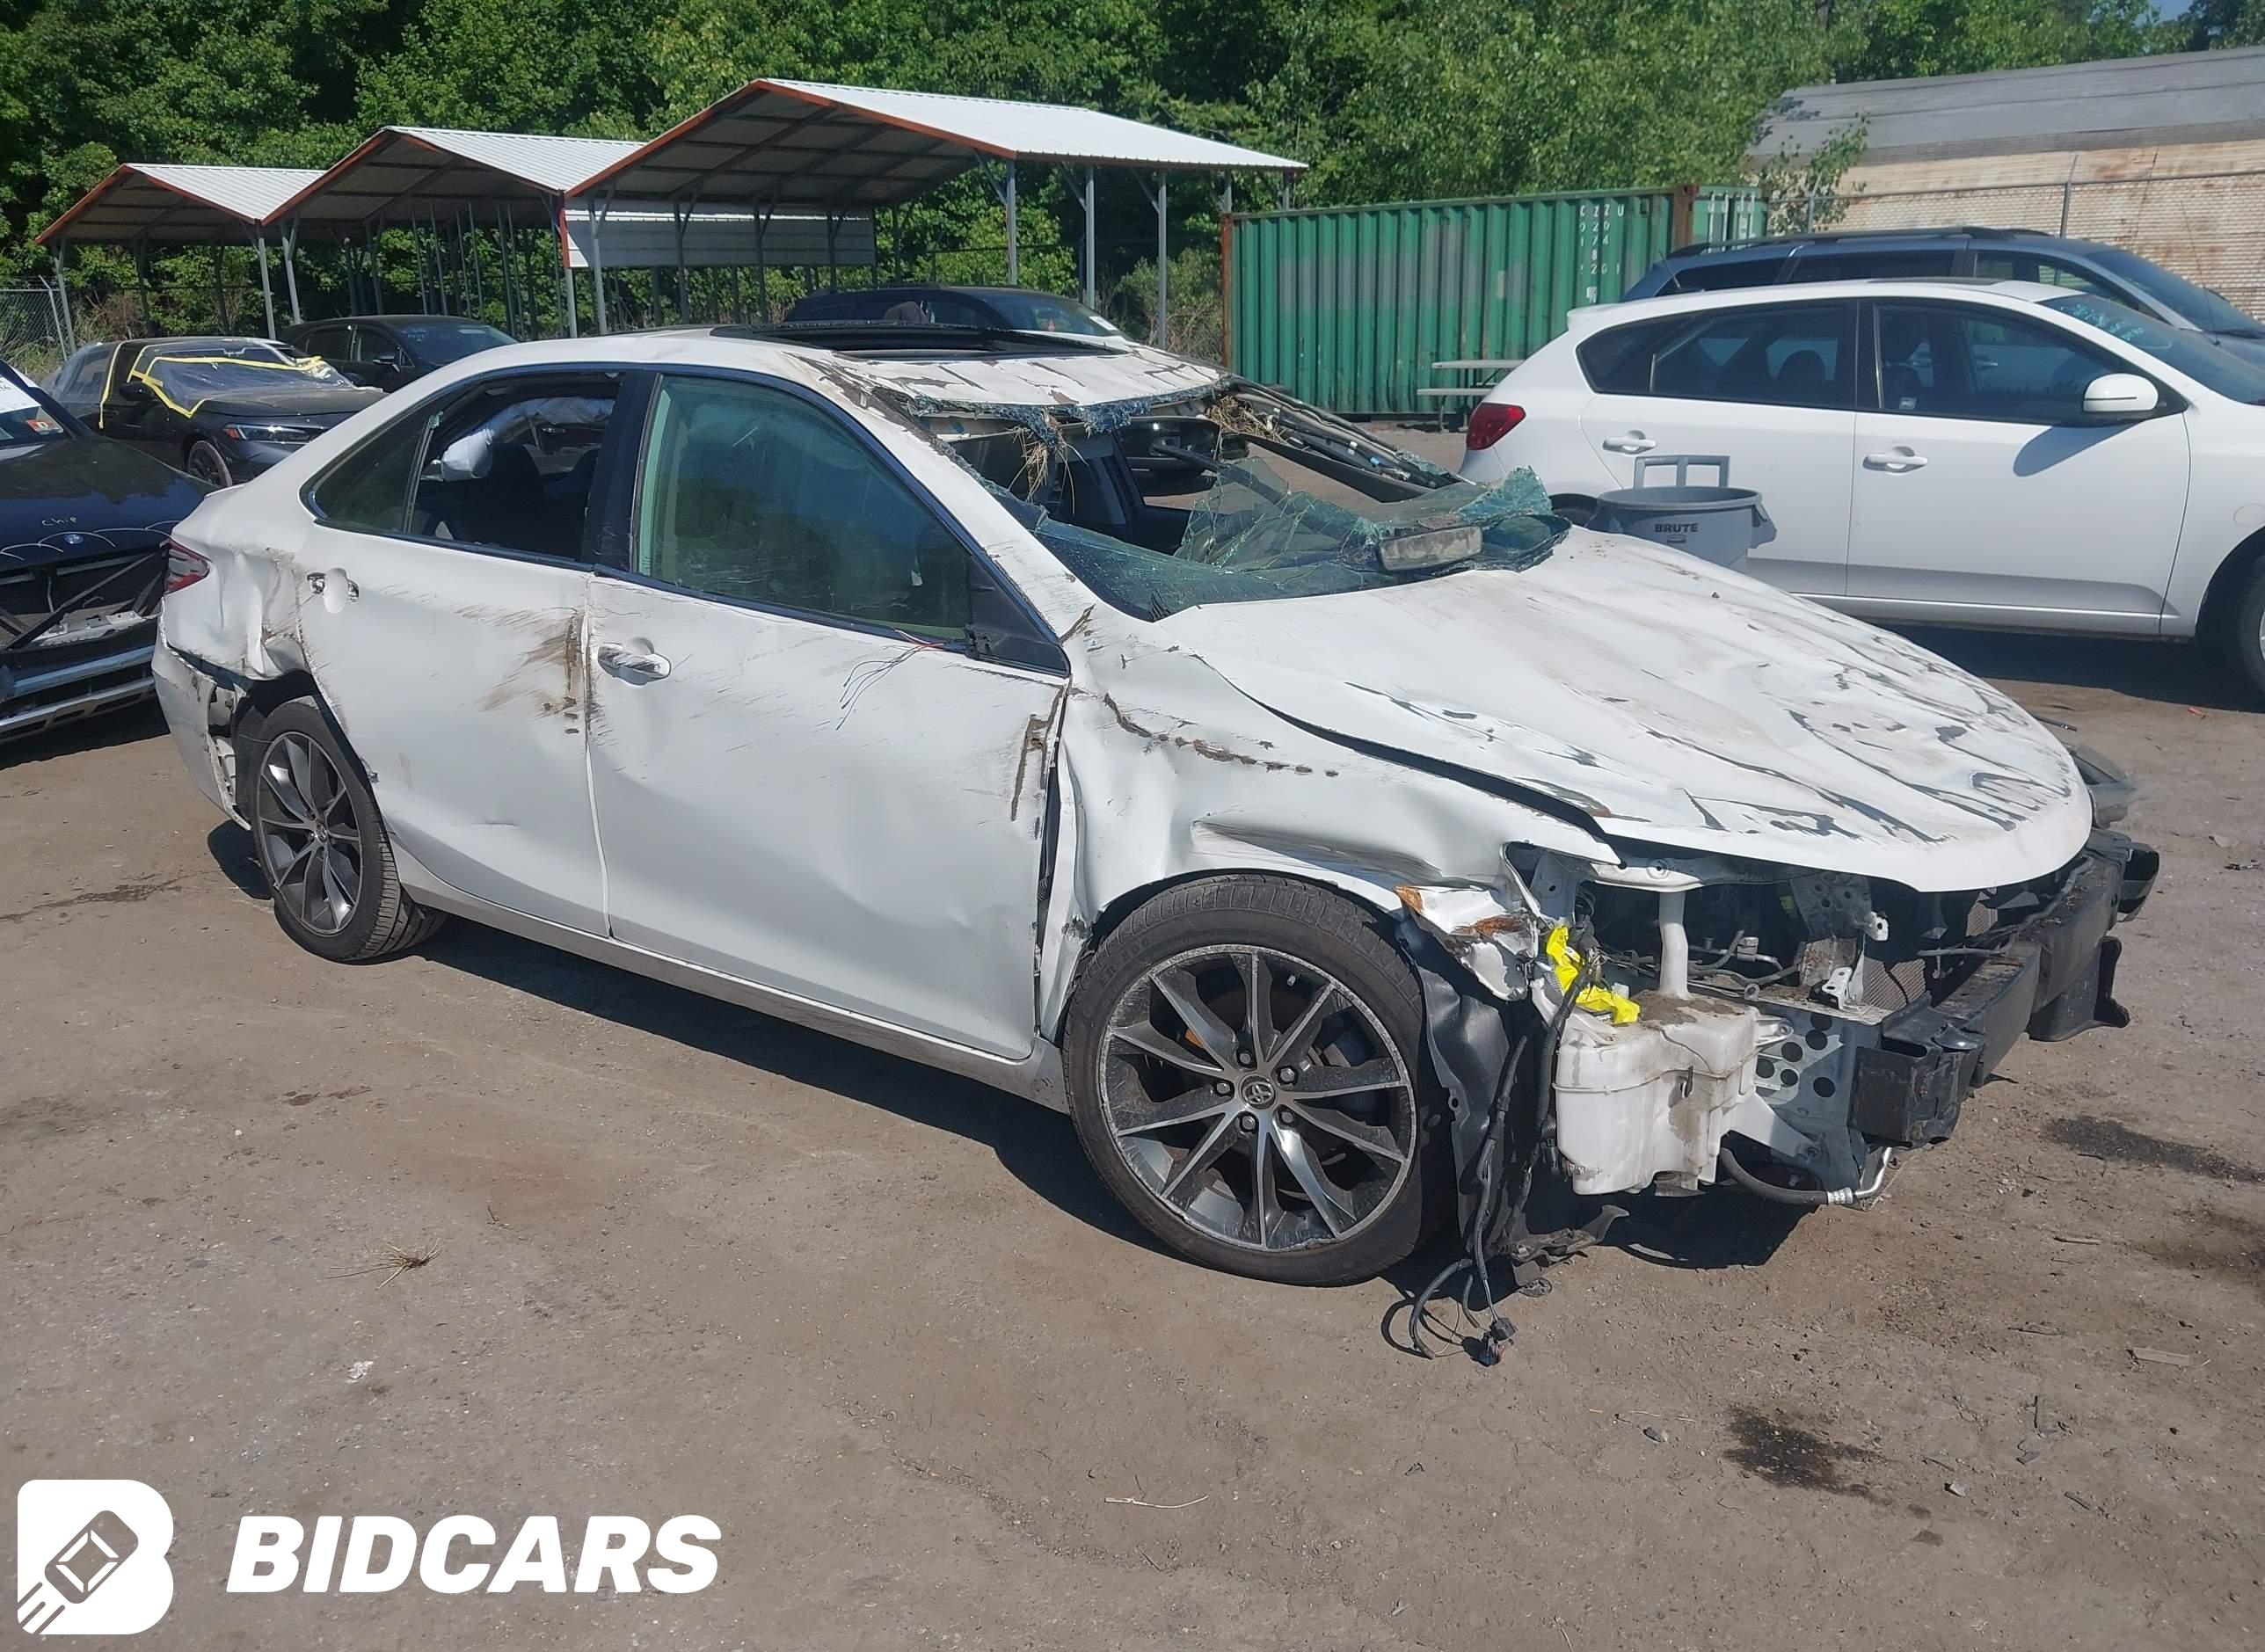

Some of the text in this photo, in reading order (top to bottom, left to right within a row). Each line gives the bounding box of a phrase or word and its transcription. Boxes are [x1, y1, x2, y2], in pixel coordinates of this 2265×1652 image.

[1579, 204, 1625, 218] CZZU
[1580, 235, 1609, 247] 174
[1591, 249, 1598, 260] 8
[1655, 522, 1699, 533] BRUTE
